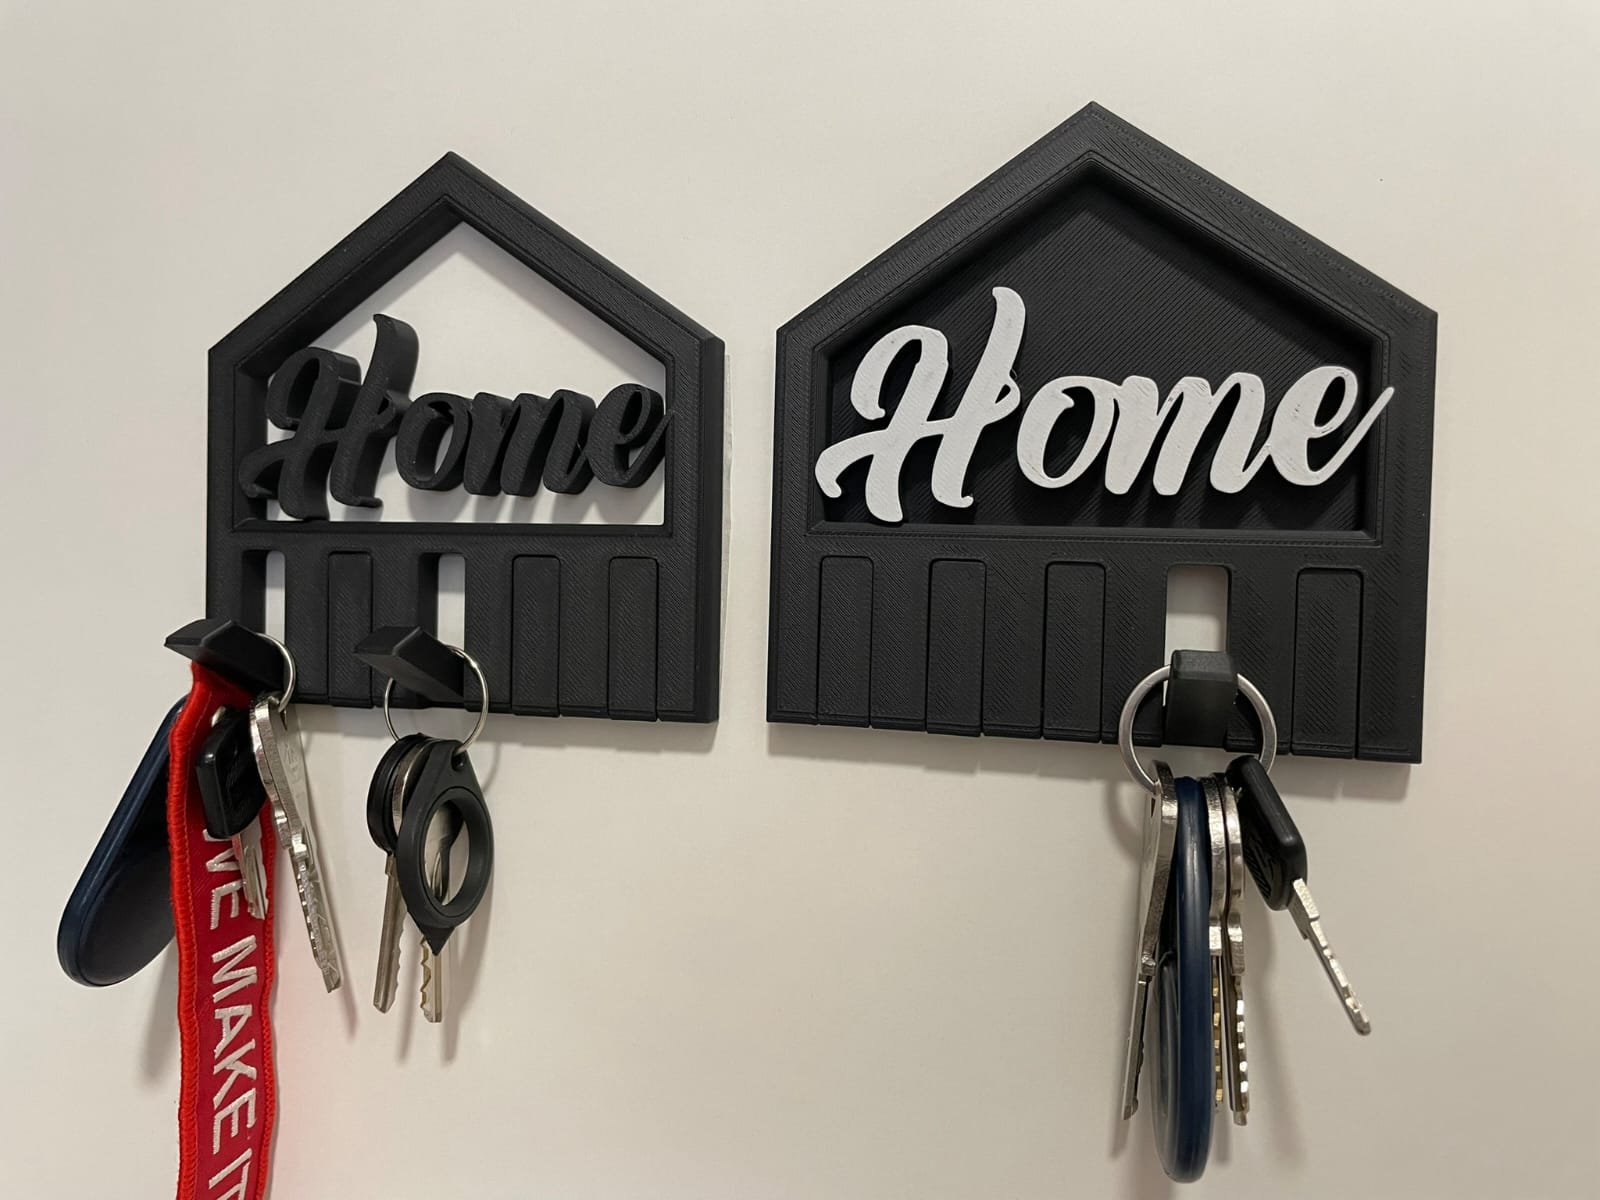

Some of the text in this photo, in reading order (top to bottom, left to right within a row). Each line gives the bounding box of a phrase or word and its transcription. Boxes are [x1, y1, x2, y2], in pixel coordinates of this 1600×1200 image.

[238, 314, 674, 521] Home
[814, 286, 1395, 523] Home
[212, 934, 258, 1155] MAKE
